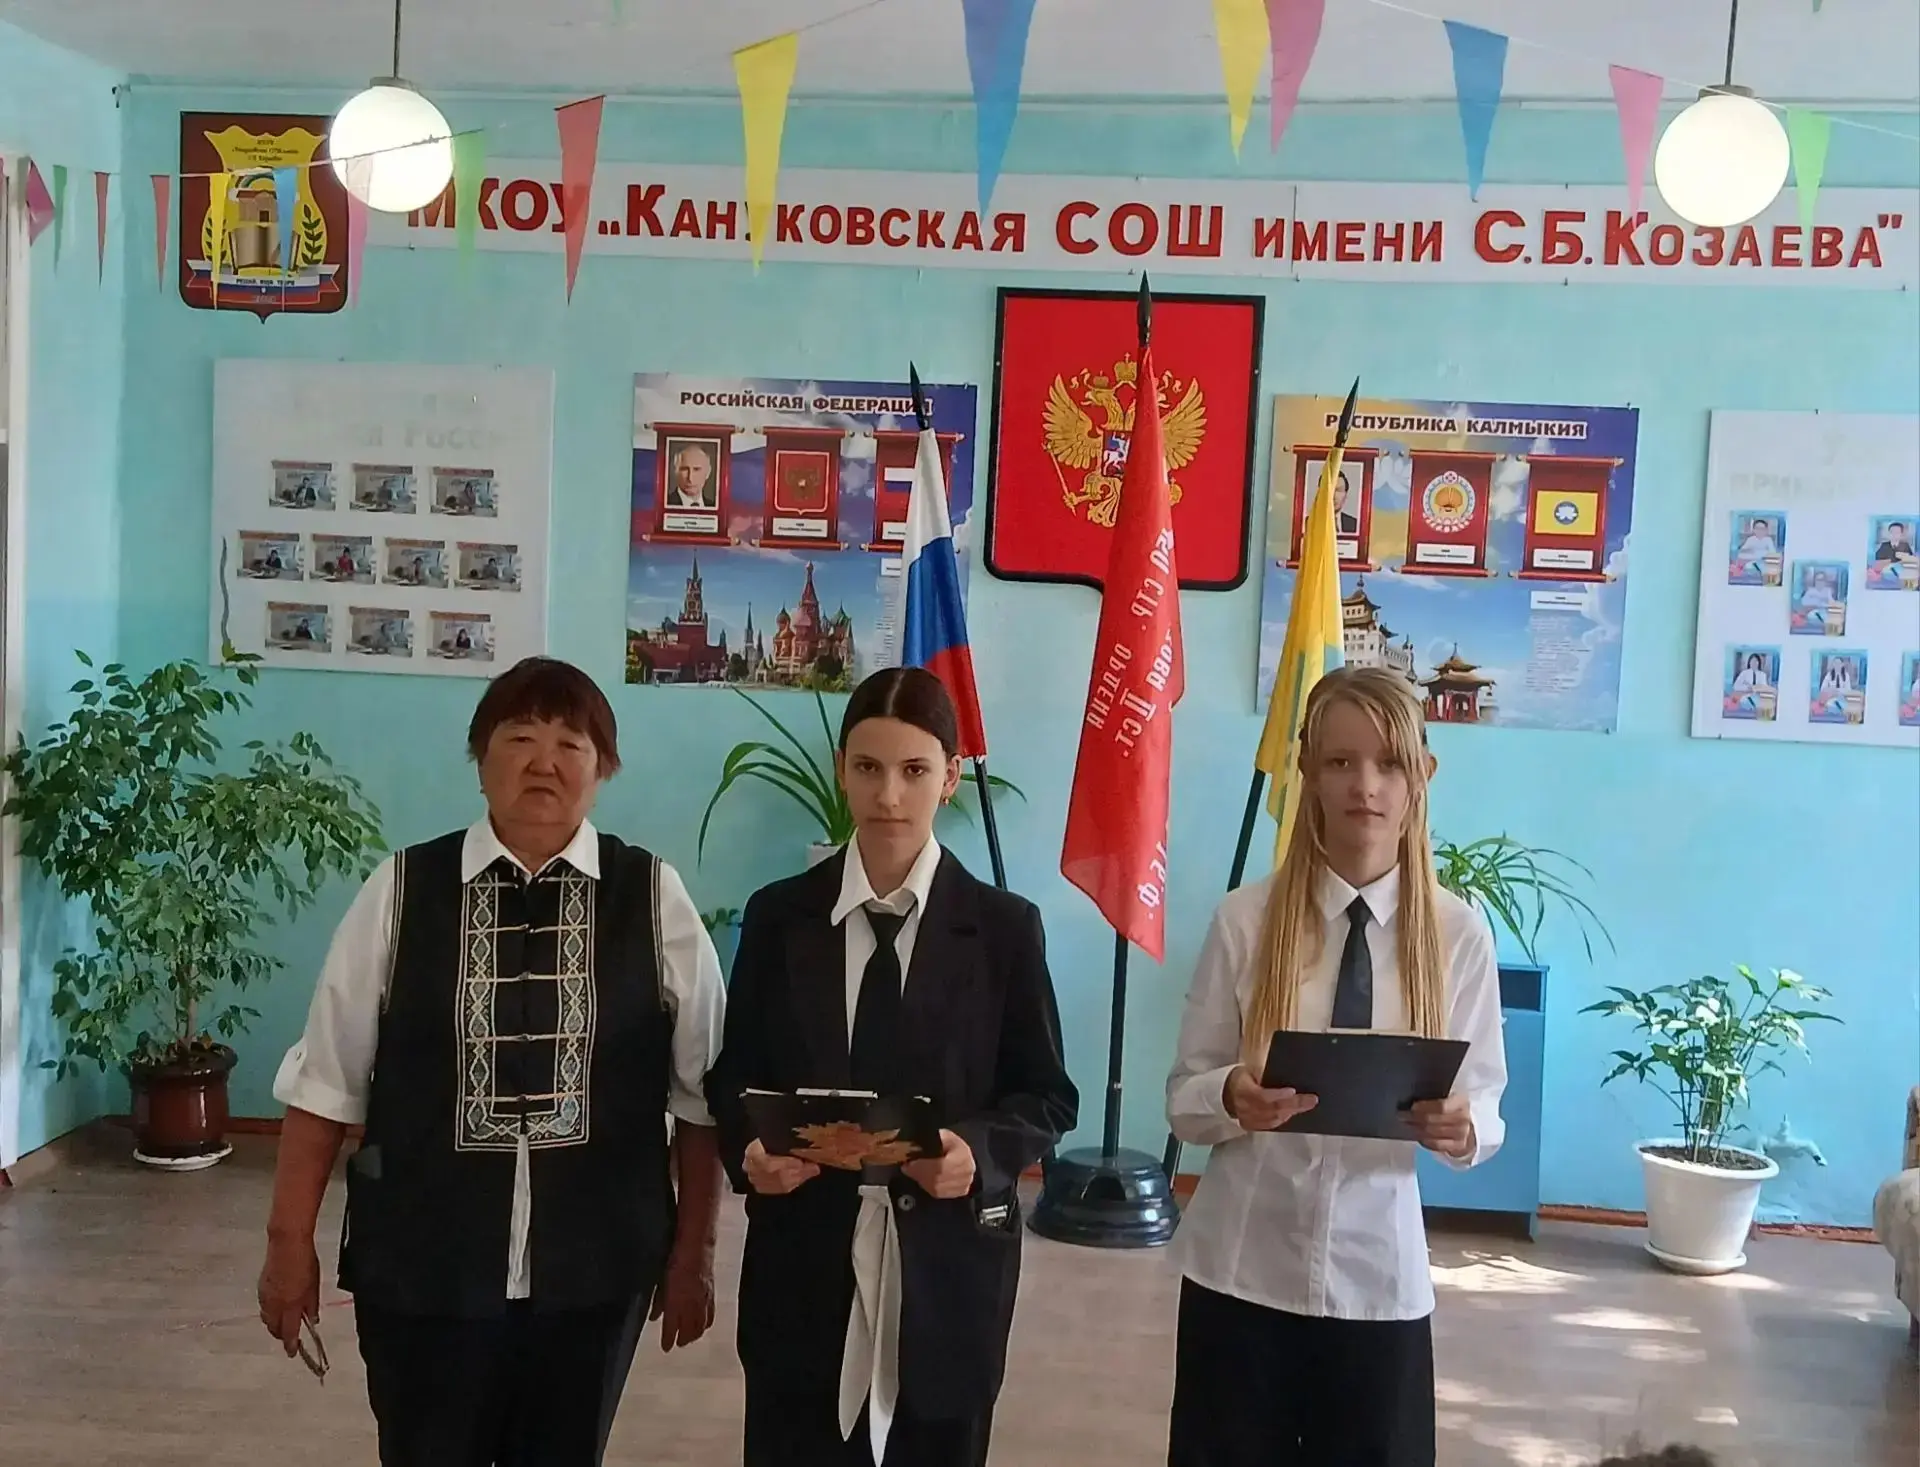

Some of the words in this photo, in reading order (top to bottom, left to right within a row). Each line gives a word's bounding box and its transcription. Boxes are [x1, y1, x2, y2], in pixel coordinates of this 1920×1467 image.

[1056, 201, 1223, 257] СОШ
[1254, 218, 1442, 263] ИМЕНИ
[680, 390, 803, 410] РОССИЙСКАЯ
[1325, 414, 1456, 431] РСПУБЛИКА
[1467, 419, 1585, 436] КАЛМЫКИЯ
